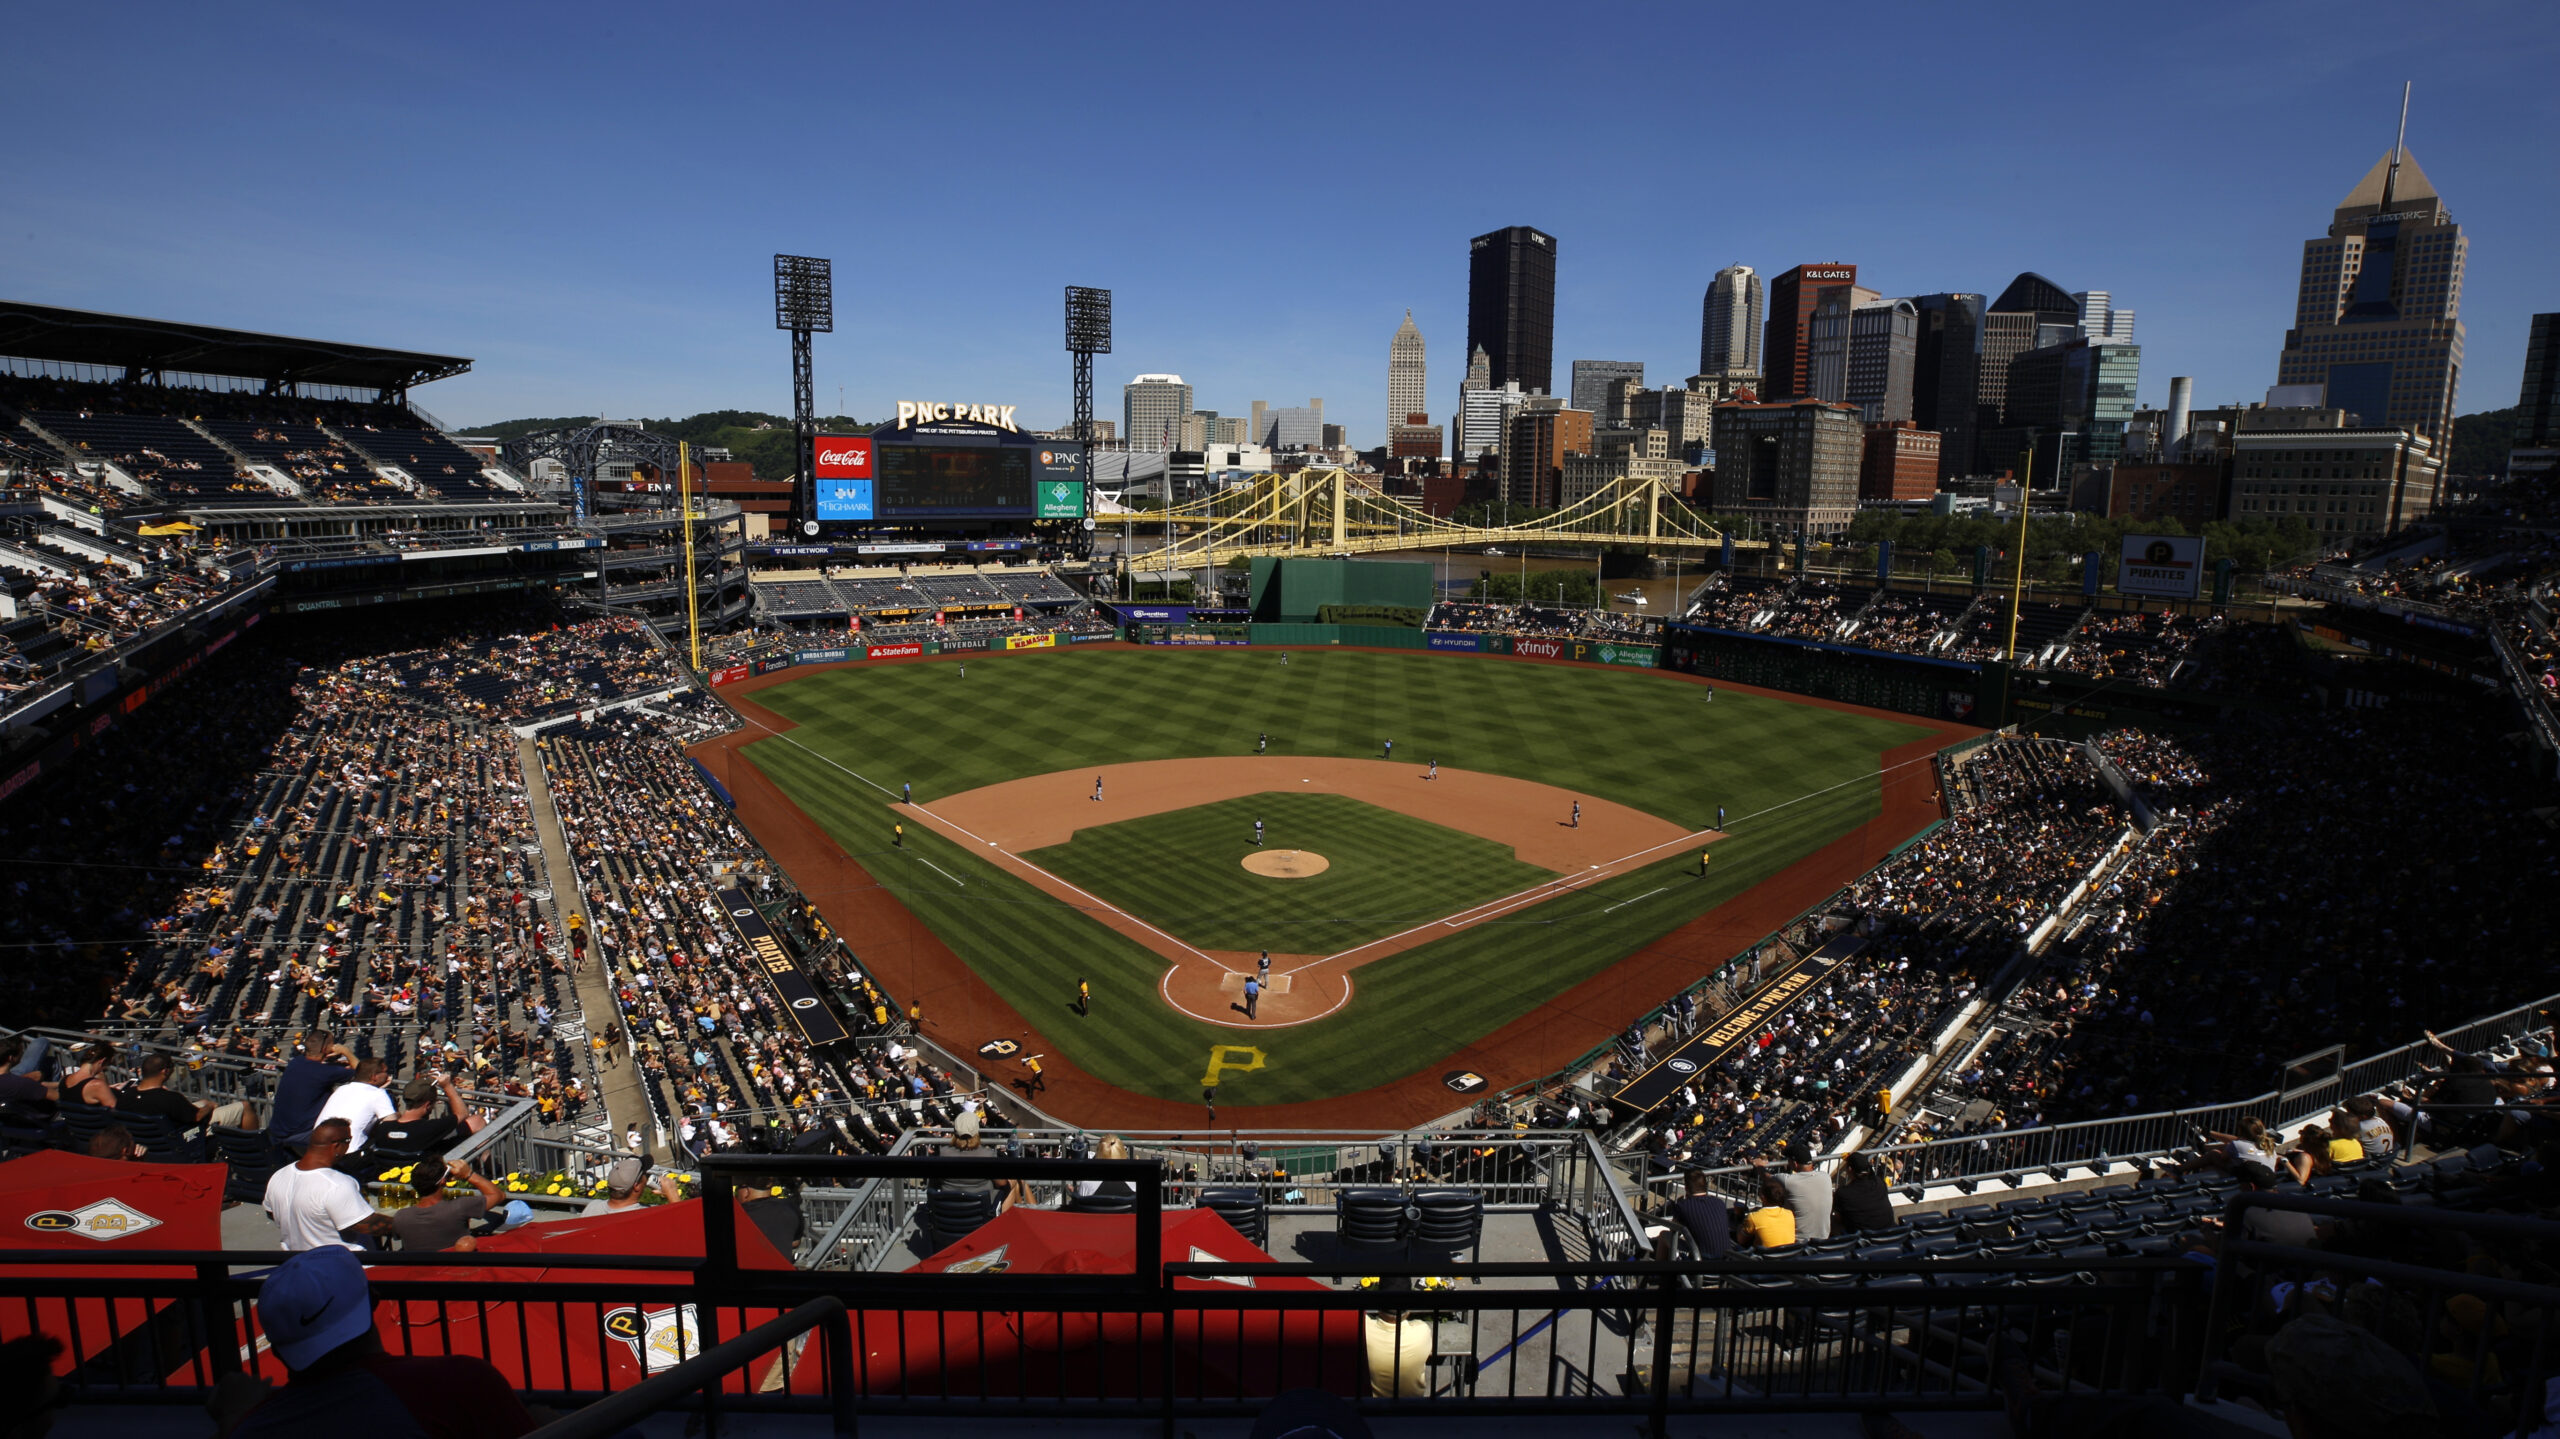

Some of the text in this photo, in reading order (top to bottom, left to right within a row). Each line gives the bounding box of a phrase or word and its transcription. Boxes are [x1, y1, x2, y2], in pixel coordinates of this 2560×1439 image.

[1531, 232, 1546, 246] UPMC
[1806, 270, 1822, 279] K&L
[1823, 270, 1850, 279] GATES
[897, 400, 1018, 434] PNC PARK
[819, 449, 867, 466] Coca-Cola
[1055, 453, 1080, 464] PNC
[819, 502, 872, 511] HIGHMARK
[1044, 504, 1077, 512] Allegheny
[2154, 546, 2168, 561] P
[2129, 567, 2185, 580] PIRATES
[297, 600, 342, 611] QUANTRILL
[1134, 610, 1168, 618] Guardian
[943, 640, 987, 649] RIVENDALE
[1444, 639, 1476, 647] HYUNDAI
[1516, 640, 1560, 658] xfinity
[1575, 645, 1586, 660] P
[1619, 650, 1653, 659] Allegheny
[766, 660, 788, 671] Fanatics
[2344, 687, 2391, 709] Lite
[751, 935, 794, 973] PIRATES
[1702, 972, 1813, 1047] WELCOME TO PNC PARK
[1200, 1044, 1268, 1087] P
[610, 1316, 638, 1335] P
